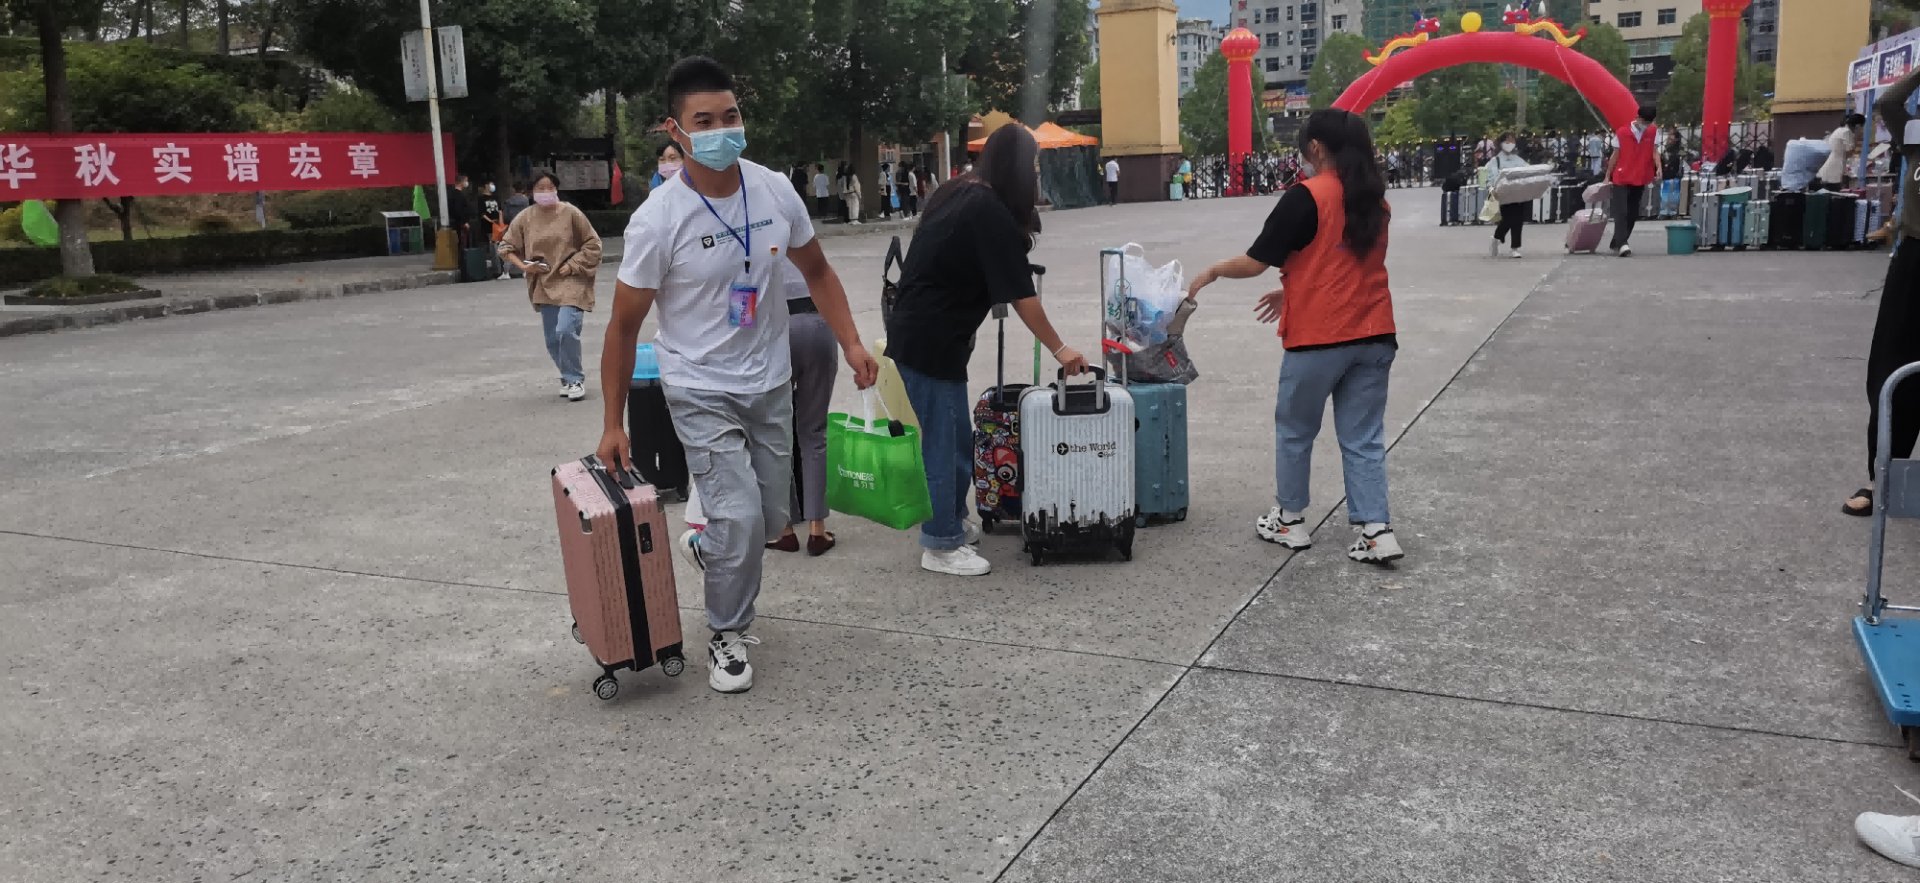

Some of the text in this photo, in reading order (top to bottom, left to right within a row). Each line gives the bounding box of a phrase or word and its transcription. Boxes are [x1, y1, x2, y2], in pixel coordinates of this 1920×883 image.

[0, 143, 379, 189] 华秋实谱宏章
[1070, 444, 1087, 452] the
[1089, 441, 1116, 451] World
